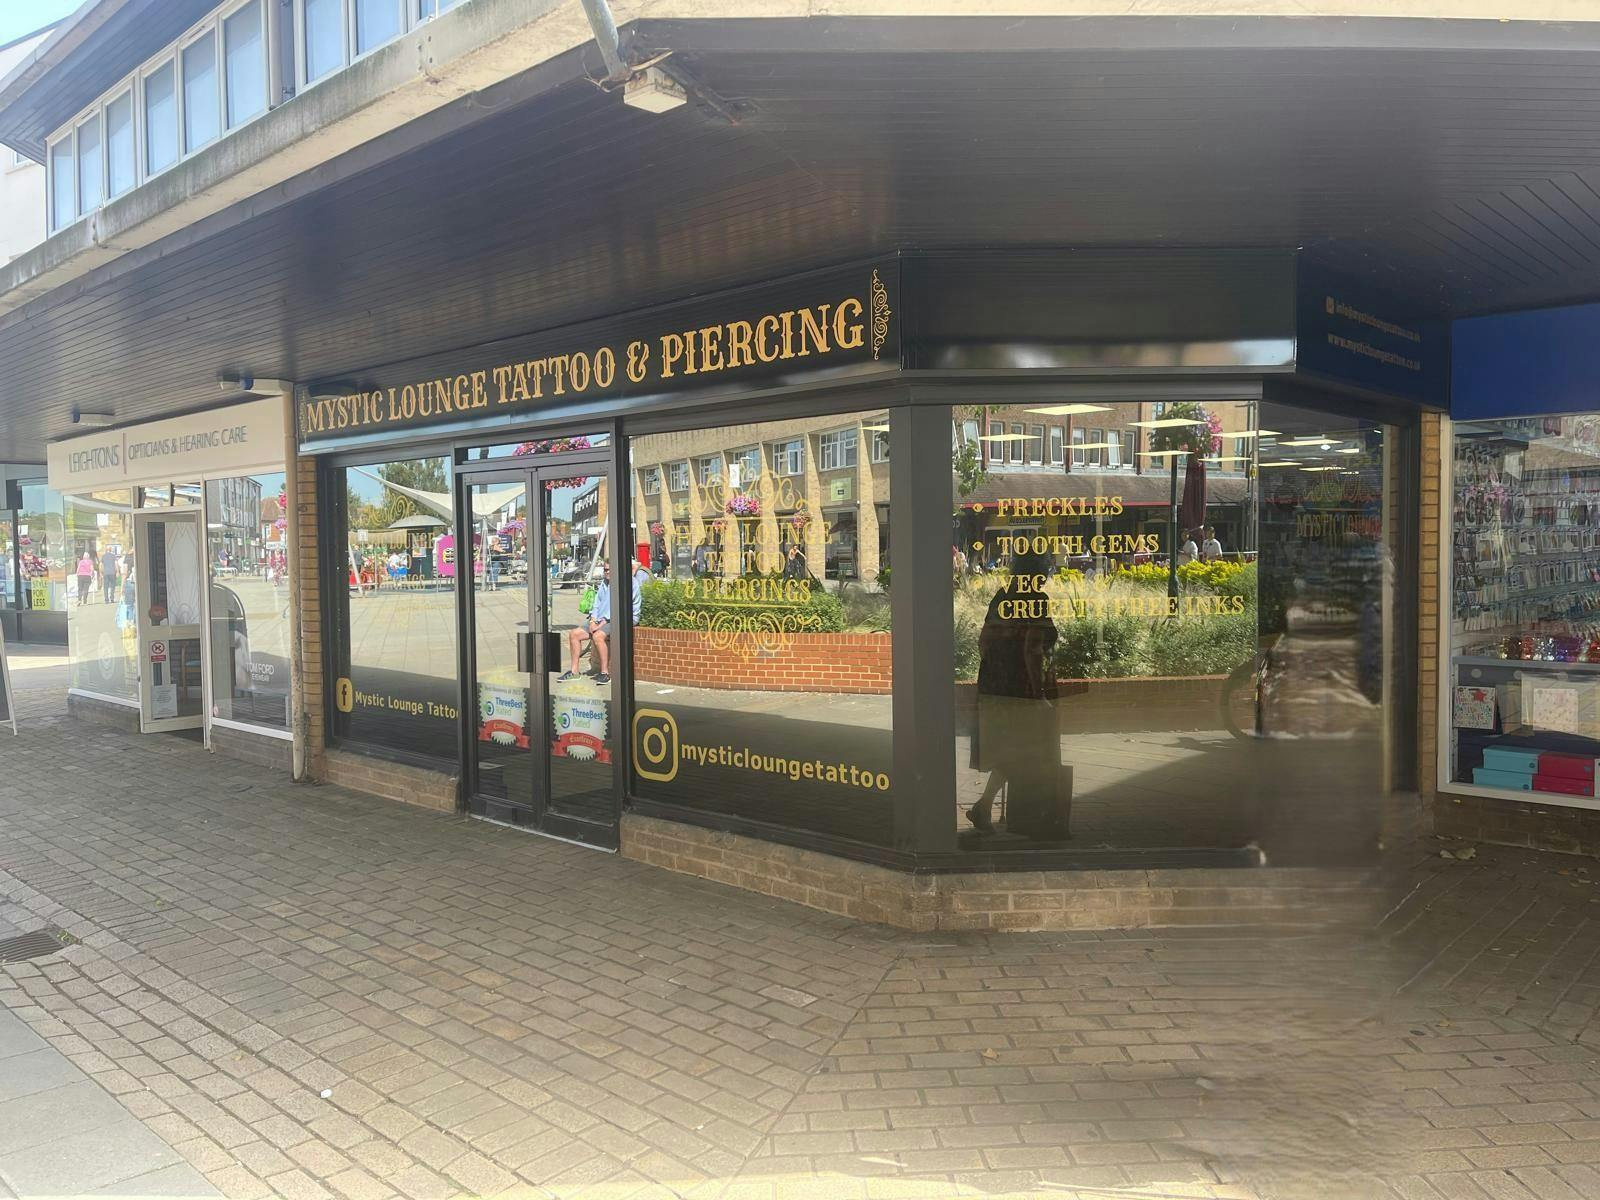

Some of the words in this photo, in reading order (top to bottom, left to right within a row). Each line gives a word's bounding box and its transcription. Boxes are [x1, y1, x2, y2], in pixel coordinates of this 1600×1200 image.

[307, 390, 384, 433] MYSTIC
[388, 369, 487, 421] LOUNGE
[493, 346, 616, 405] TATTOO
[625, 341, 649, 383] &
[660, 298, 865, 379] PIERCING
[68, 444, 120, 473] LEIGHTONS
[128, 438, 170, 460] OPTICIANS
[171, 438, 178, 454] &
[179, 430, 220, 451] HEARING
[221, 425, 248, 445] CARE
[997, 496, 1123, 517] FRECKLES
[744, 521, 833, 545] LOUNGE
[997, 535, 1084, 556] TOOTH
[1090, 533, 1160, 554] GEMS
[702, 577, 812, 602] PIERCINGS
[34, 599, 46, 607] LESS
[1184, 594, 1245, 616] INKS
[258, 663, 275, 675] FORD
[355, 691, 385, 708] Mystic
[388, 696, 424, 715] Lounge
[495, 697, 523, 709] ThreeBest
[572, 708, 604, 720] ThreeBest
[681, 742, 891, 791] mysticloungetattoo
